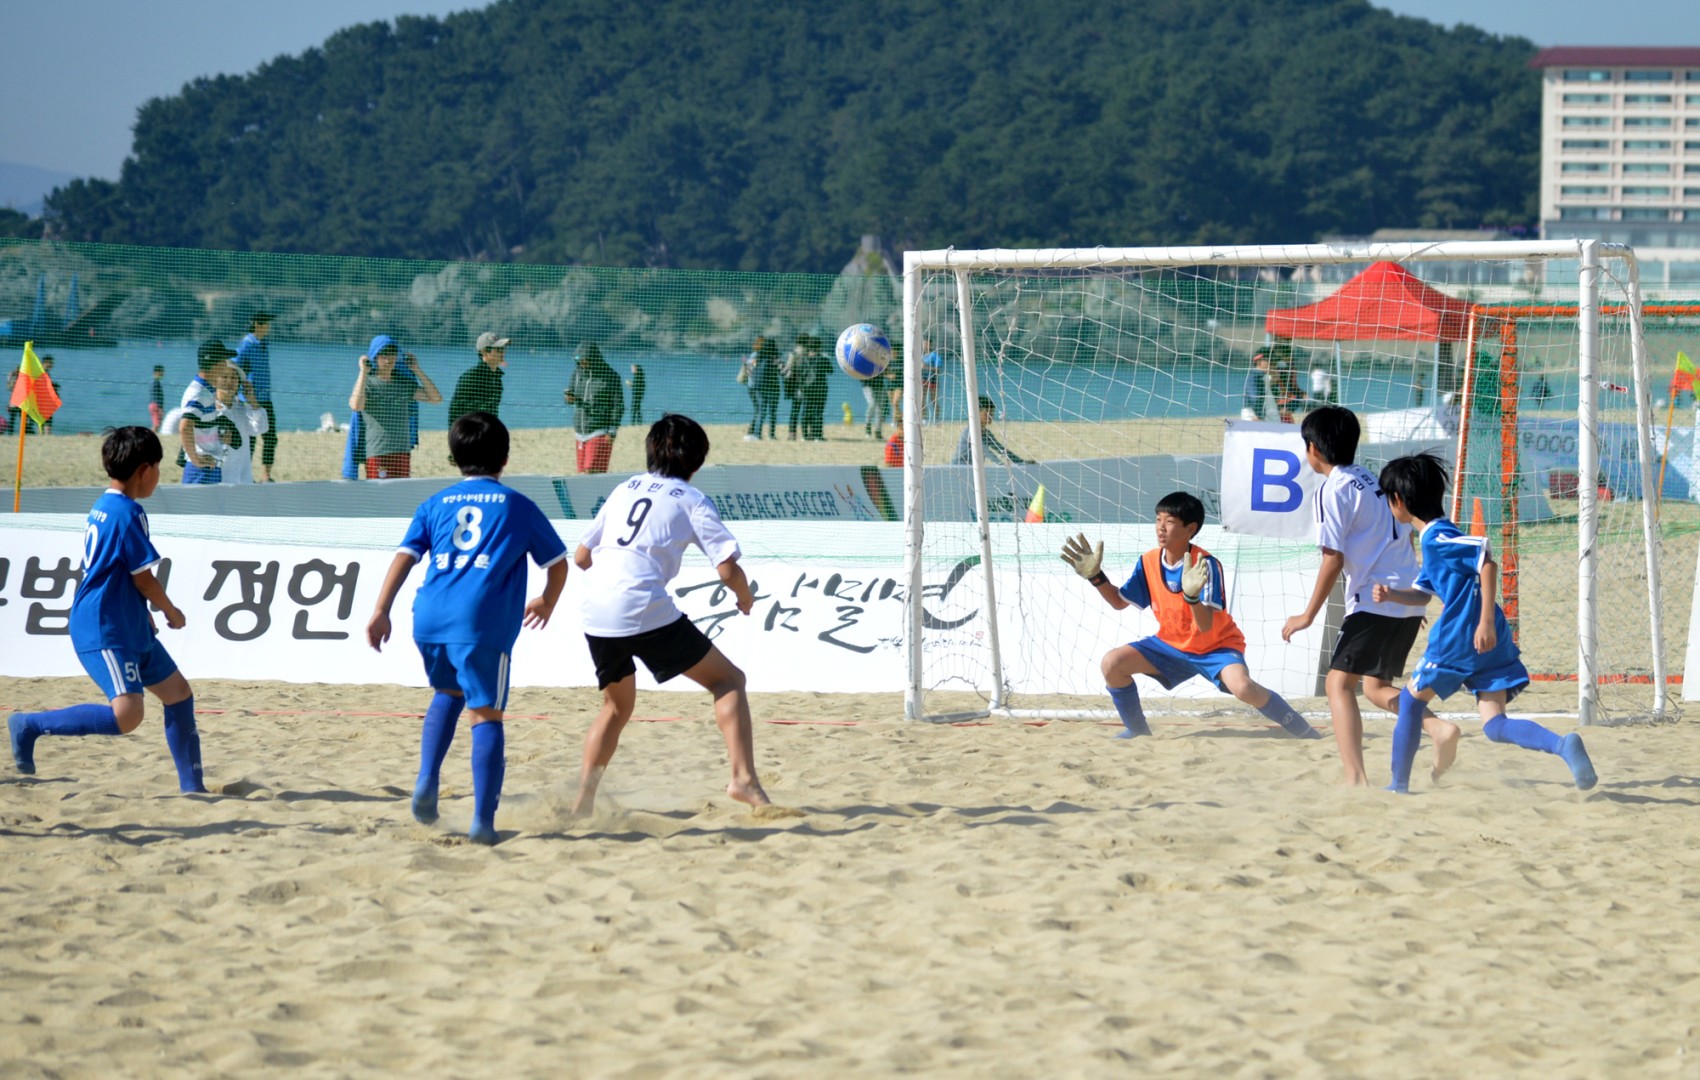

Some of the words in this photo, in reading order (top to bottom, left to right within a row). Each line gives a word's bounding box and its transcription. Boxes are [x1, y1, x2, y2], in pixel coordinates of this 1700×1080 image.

[735, 492, 788, 520] BEACH
[784, 490, 840, 517] SOCCER
[1250, 448, 1304, 512] B
[84, 520, 99, 570] 0
[452, 505, 483, 551] 8
[616, 497, 653, 547] 9
